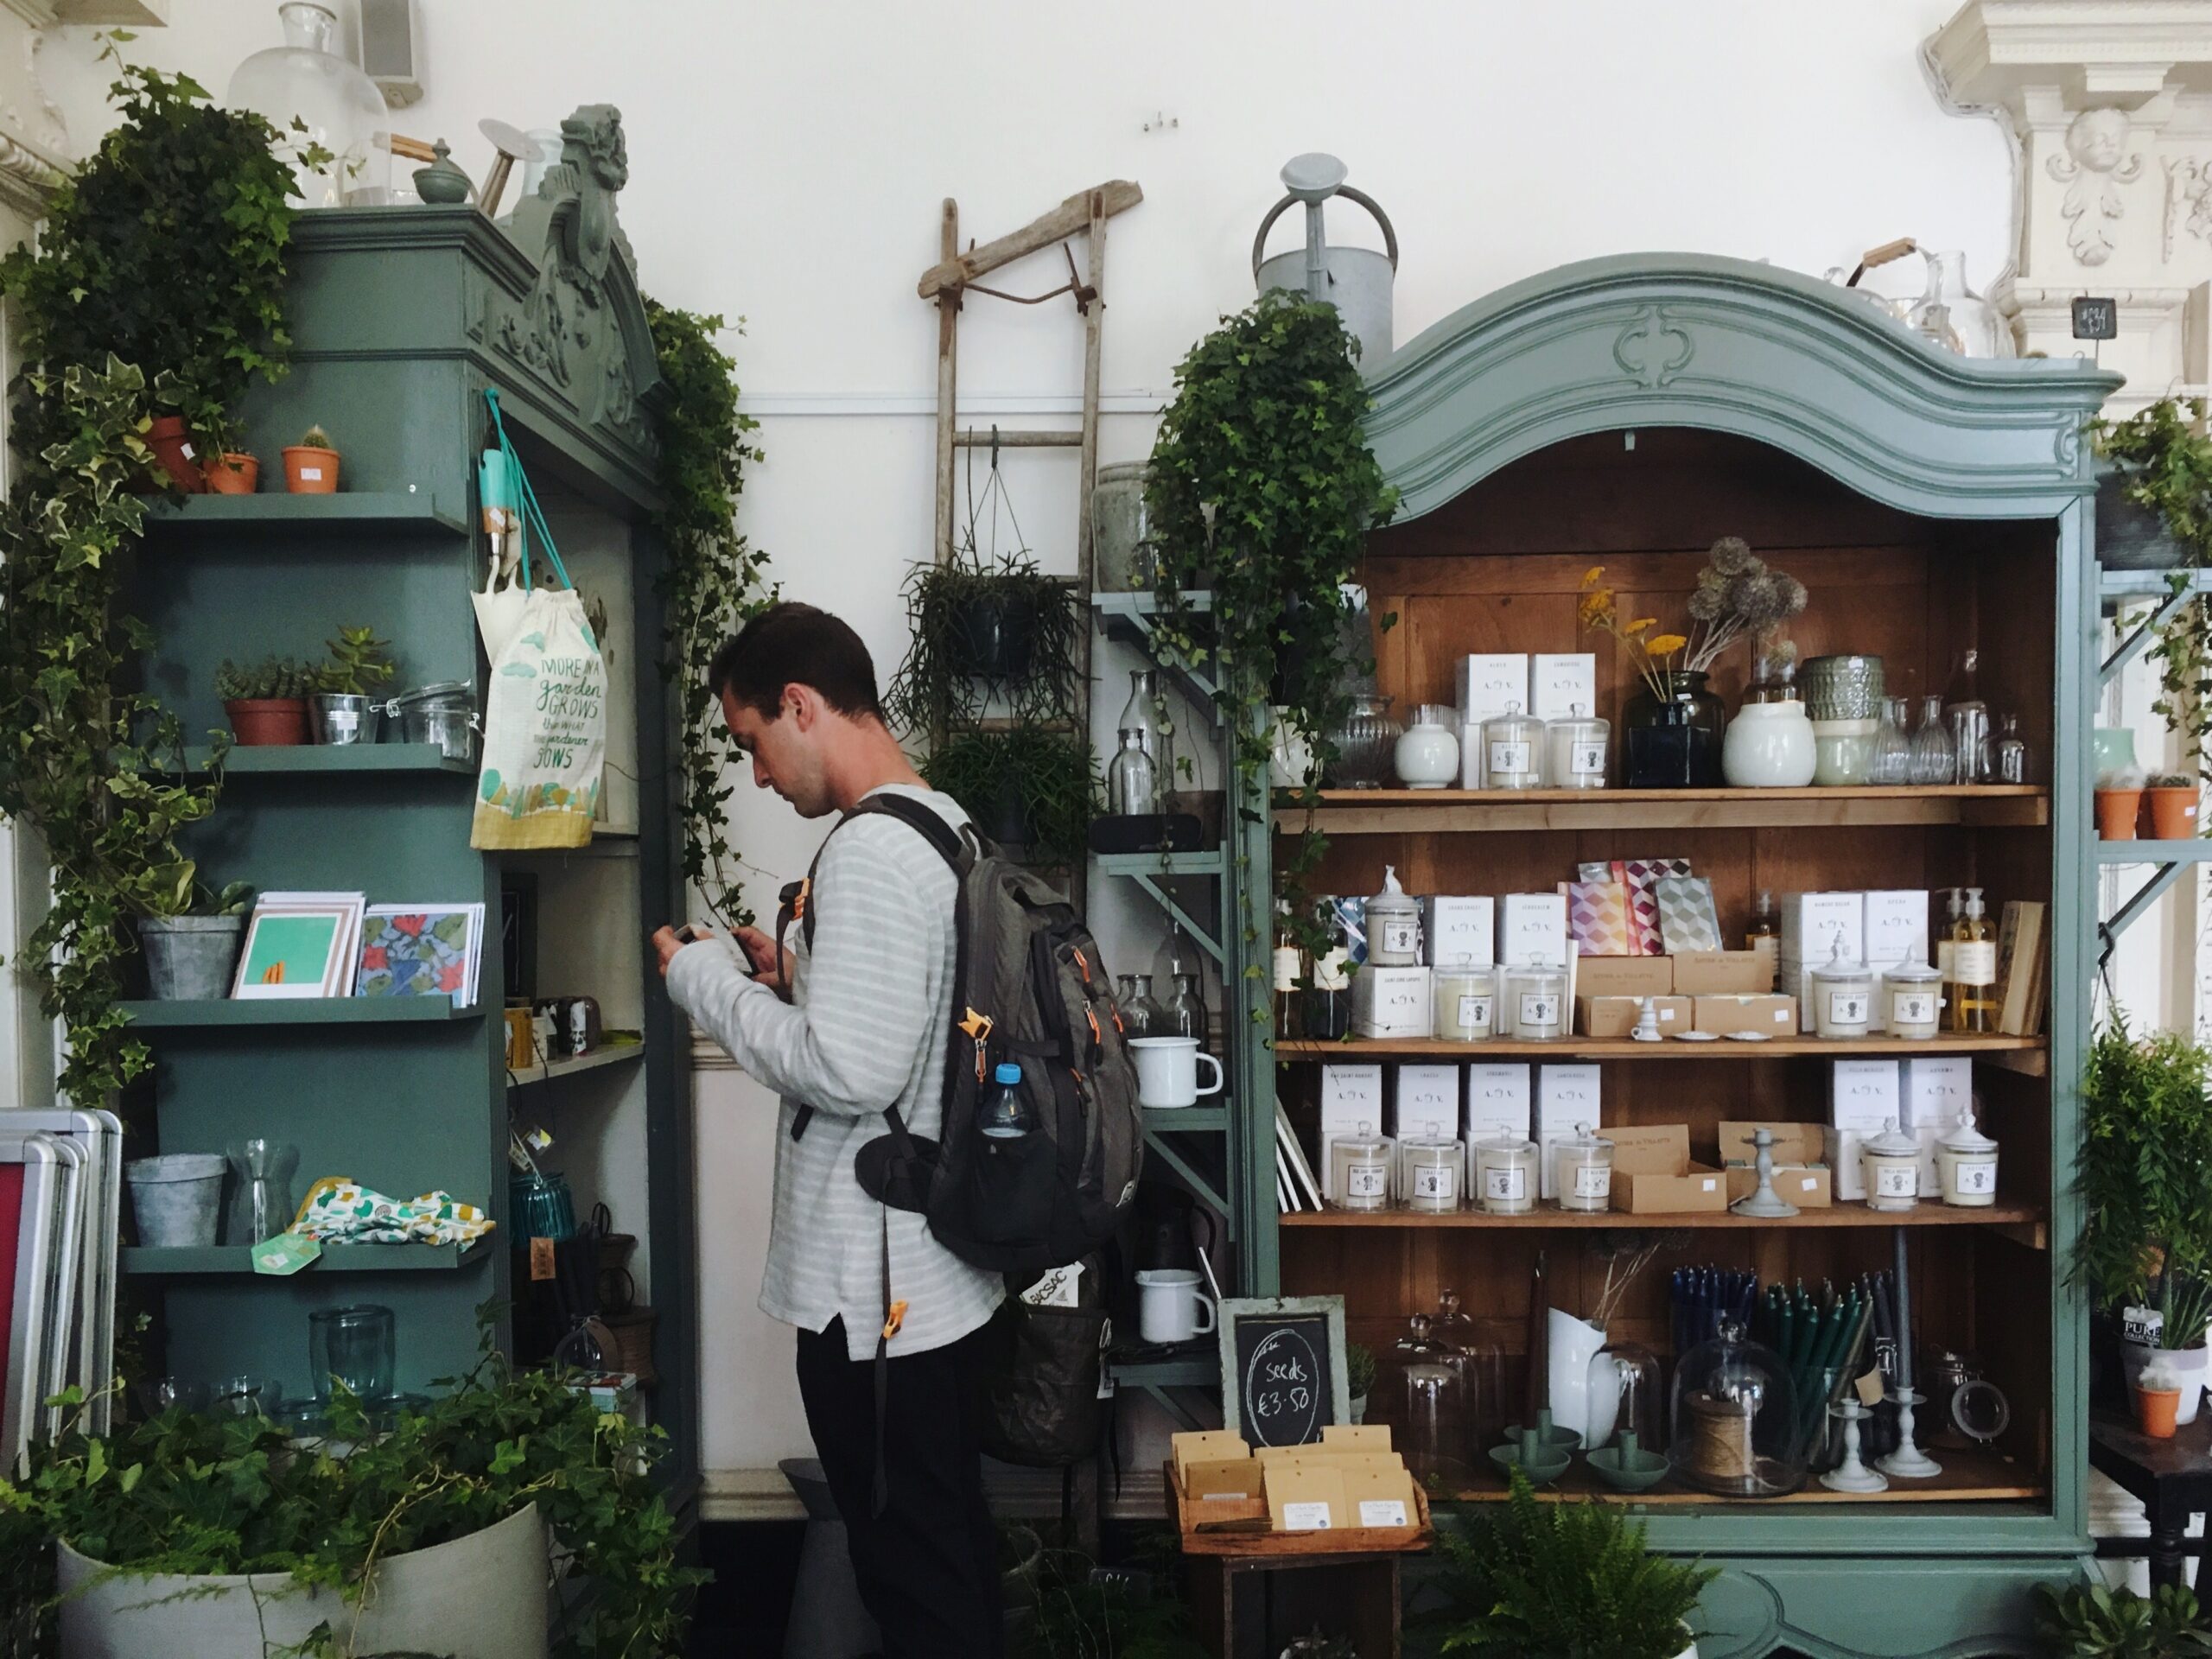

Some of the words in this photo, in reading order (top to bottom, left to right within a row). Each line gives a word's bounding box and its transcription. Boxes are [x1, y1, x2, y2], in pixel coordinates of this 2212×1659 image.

[541, 658, 582, 677] MORE
[594, 660, 600, 676] A
[537, 676, 601, 711] garden
[549, 695, 598, 719] GROWS
[533, 747, 574, 769] SOWS
[2126, 1322, 2160, 1338] PURE
